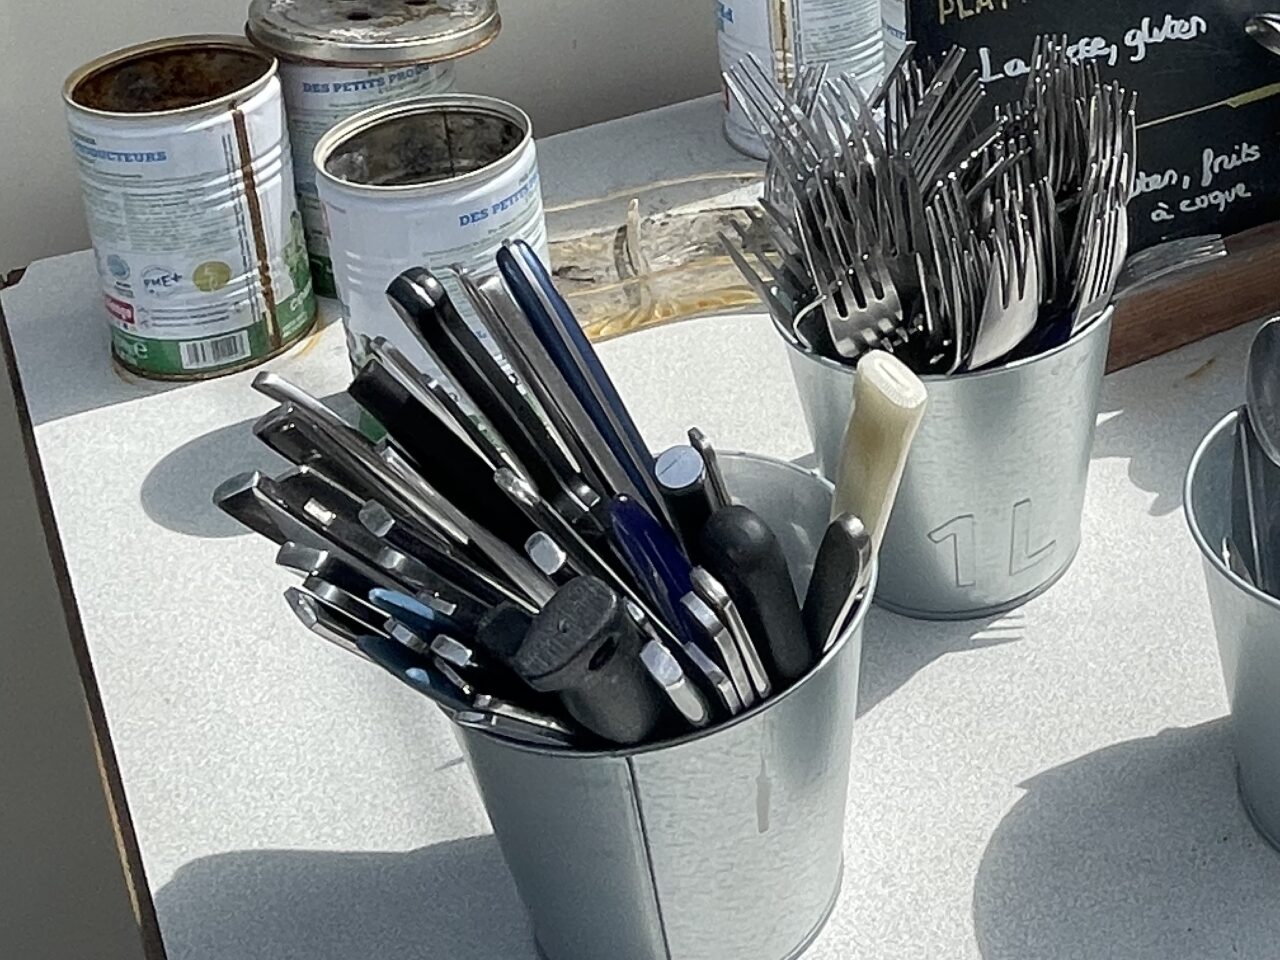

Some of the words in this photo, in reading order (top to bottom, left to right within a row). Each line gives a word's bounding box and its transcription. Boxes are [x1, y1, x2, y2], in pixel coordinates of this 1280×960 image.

[1124, 13, 1207, 62] gluten
[303, 81, 330, 93] DES
[332, 76, 385, 93] PETITS
[1201, 142, 1261, 187] fruits
[459, 208, 489, 227] DES
[1150, 201, 1175, 223] à
[1179, 182, 1252, 212] coque
